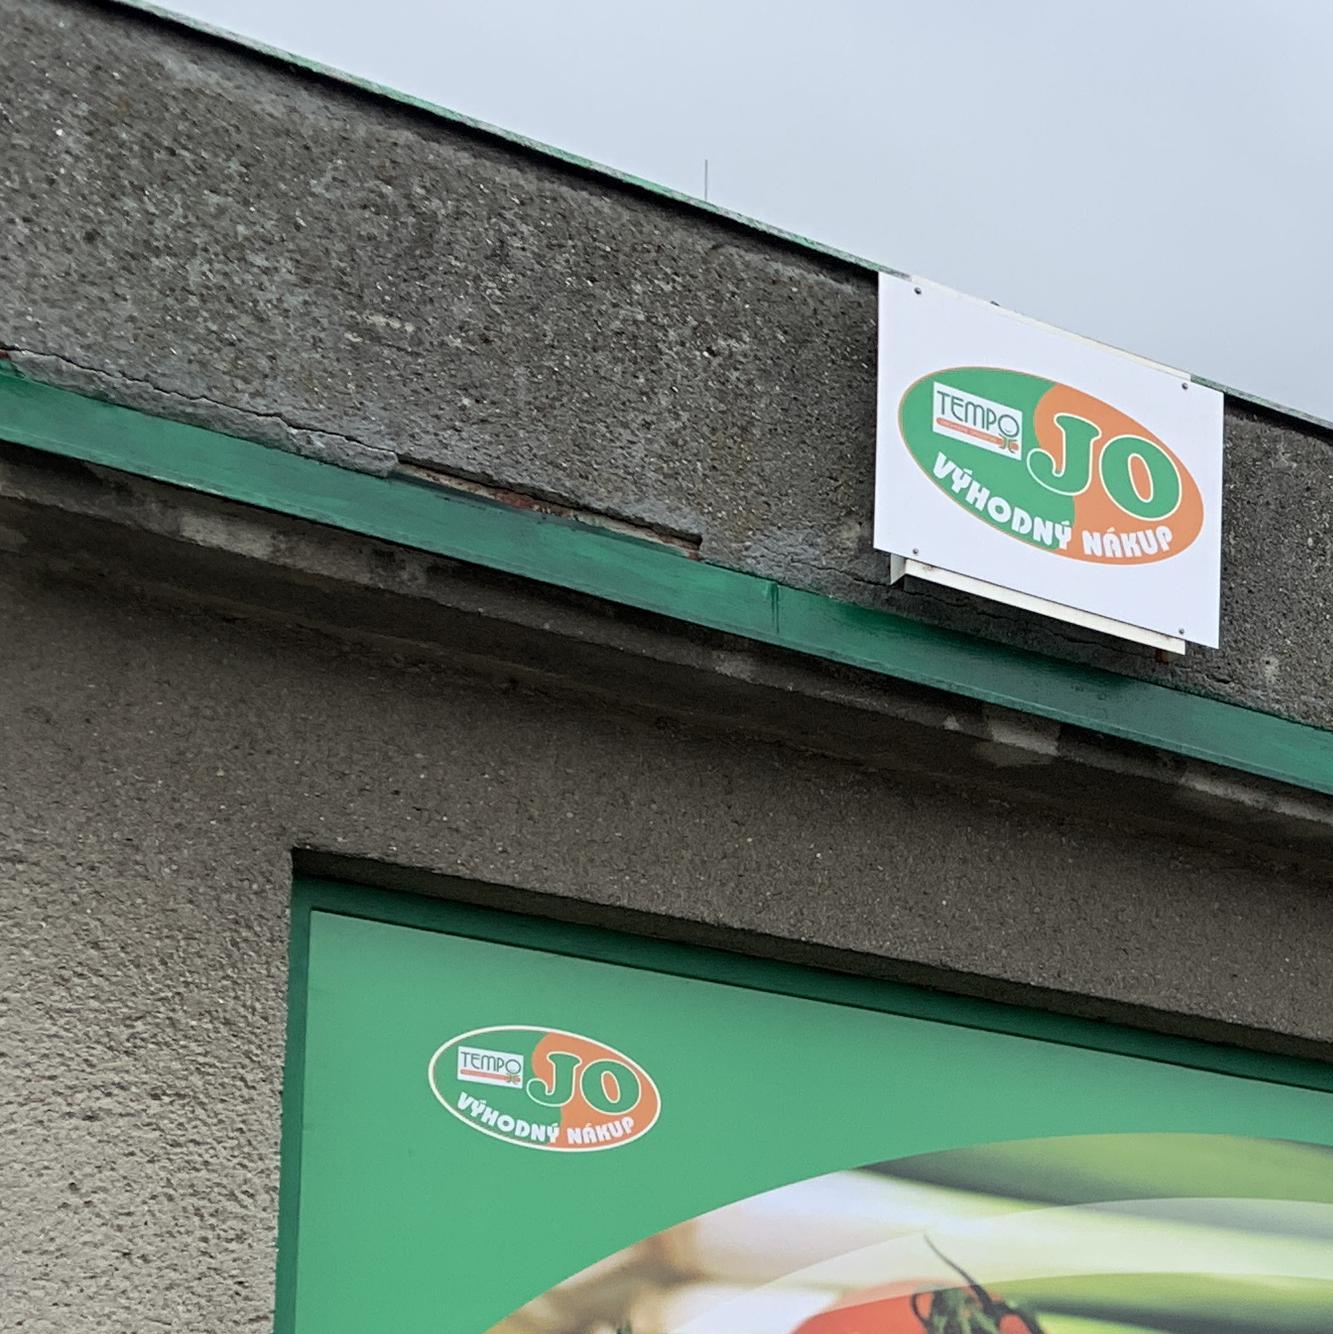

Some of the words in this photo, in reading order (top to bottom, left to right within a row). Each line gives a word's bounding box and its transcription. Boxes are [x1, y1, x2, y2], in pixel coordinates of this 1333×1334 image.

[937, 391, 1020, 438] TEMPO
[1027, 412, 1182, 521] JO
[933, 451, 1072, 550] VÝHODNÝ
[1082, 526, 1173, 558] NÁKUP
[460, 1051, 521, 1075] TEMPO
[526, 1051, 641, 1115] JO
[457, 1092, 559, 1143] VÝHODNÝ
[567, 1117, 634, 1144] NÁKUP
